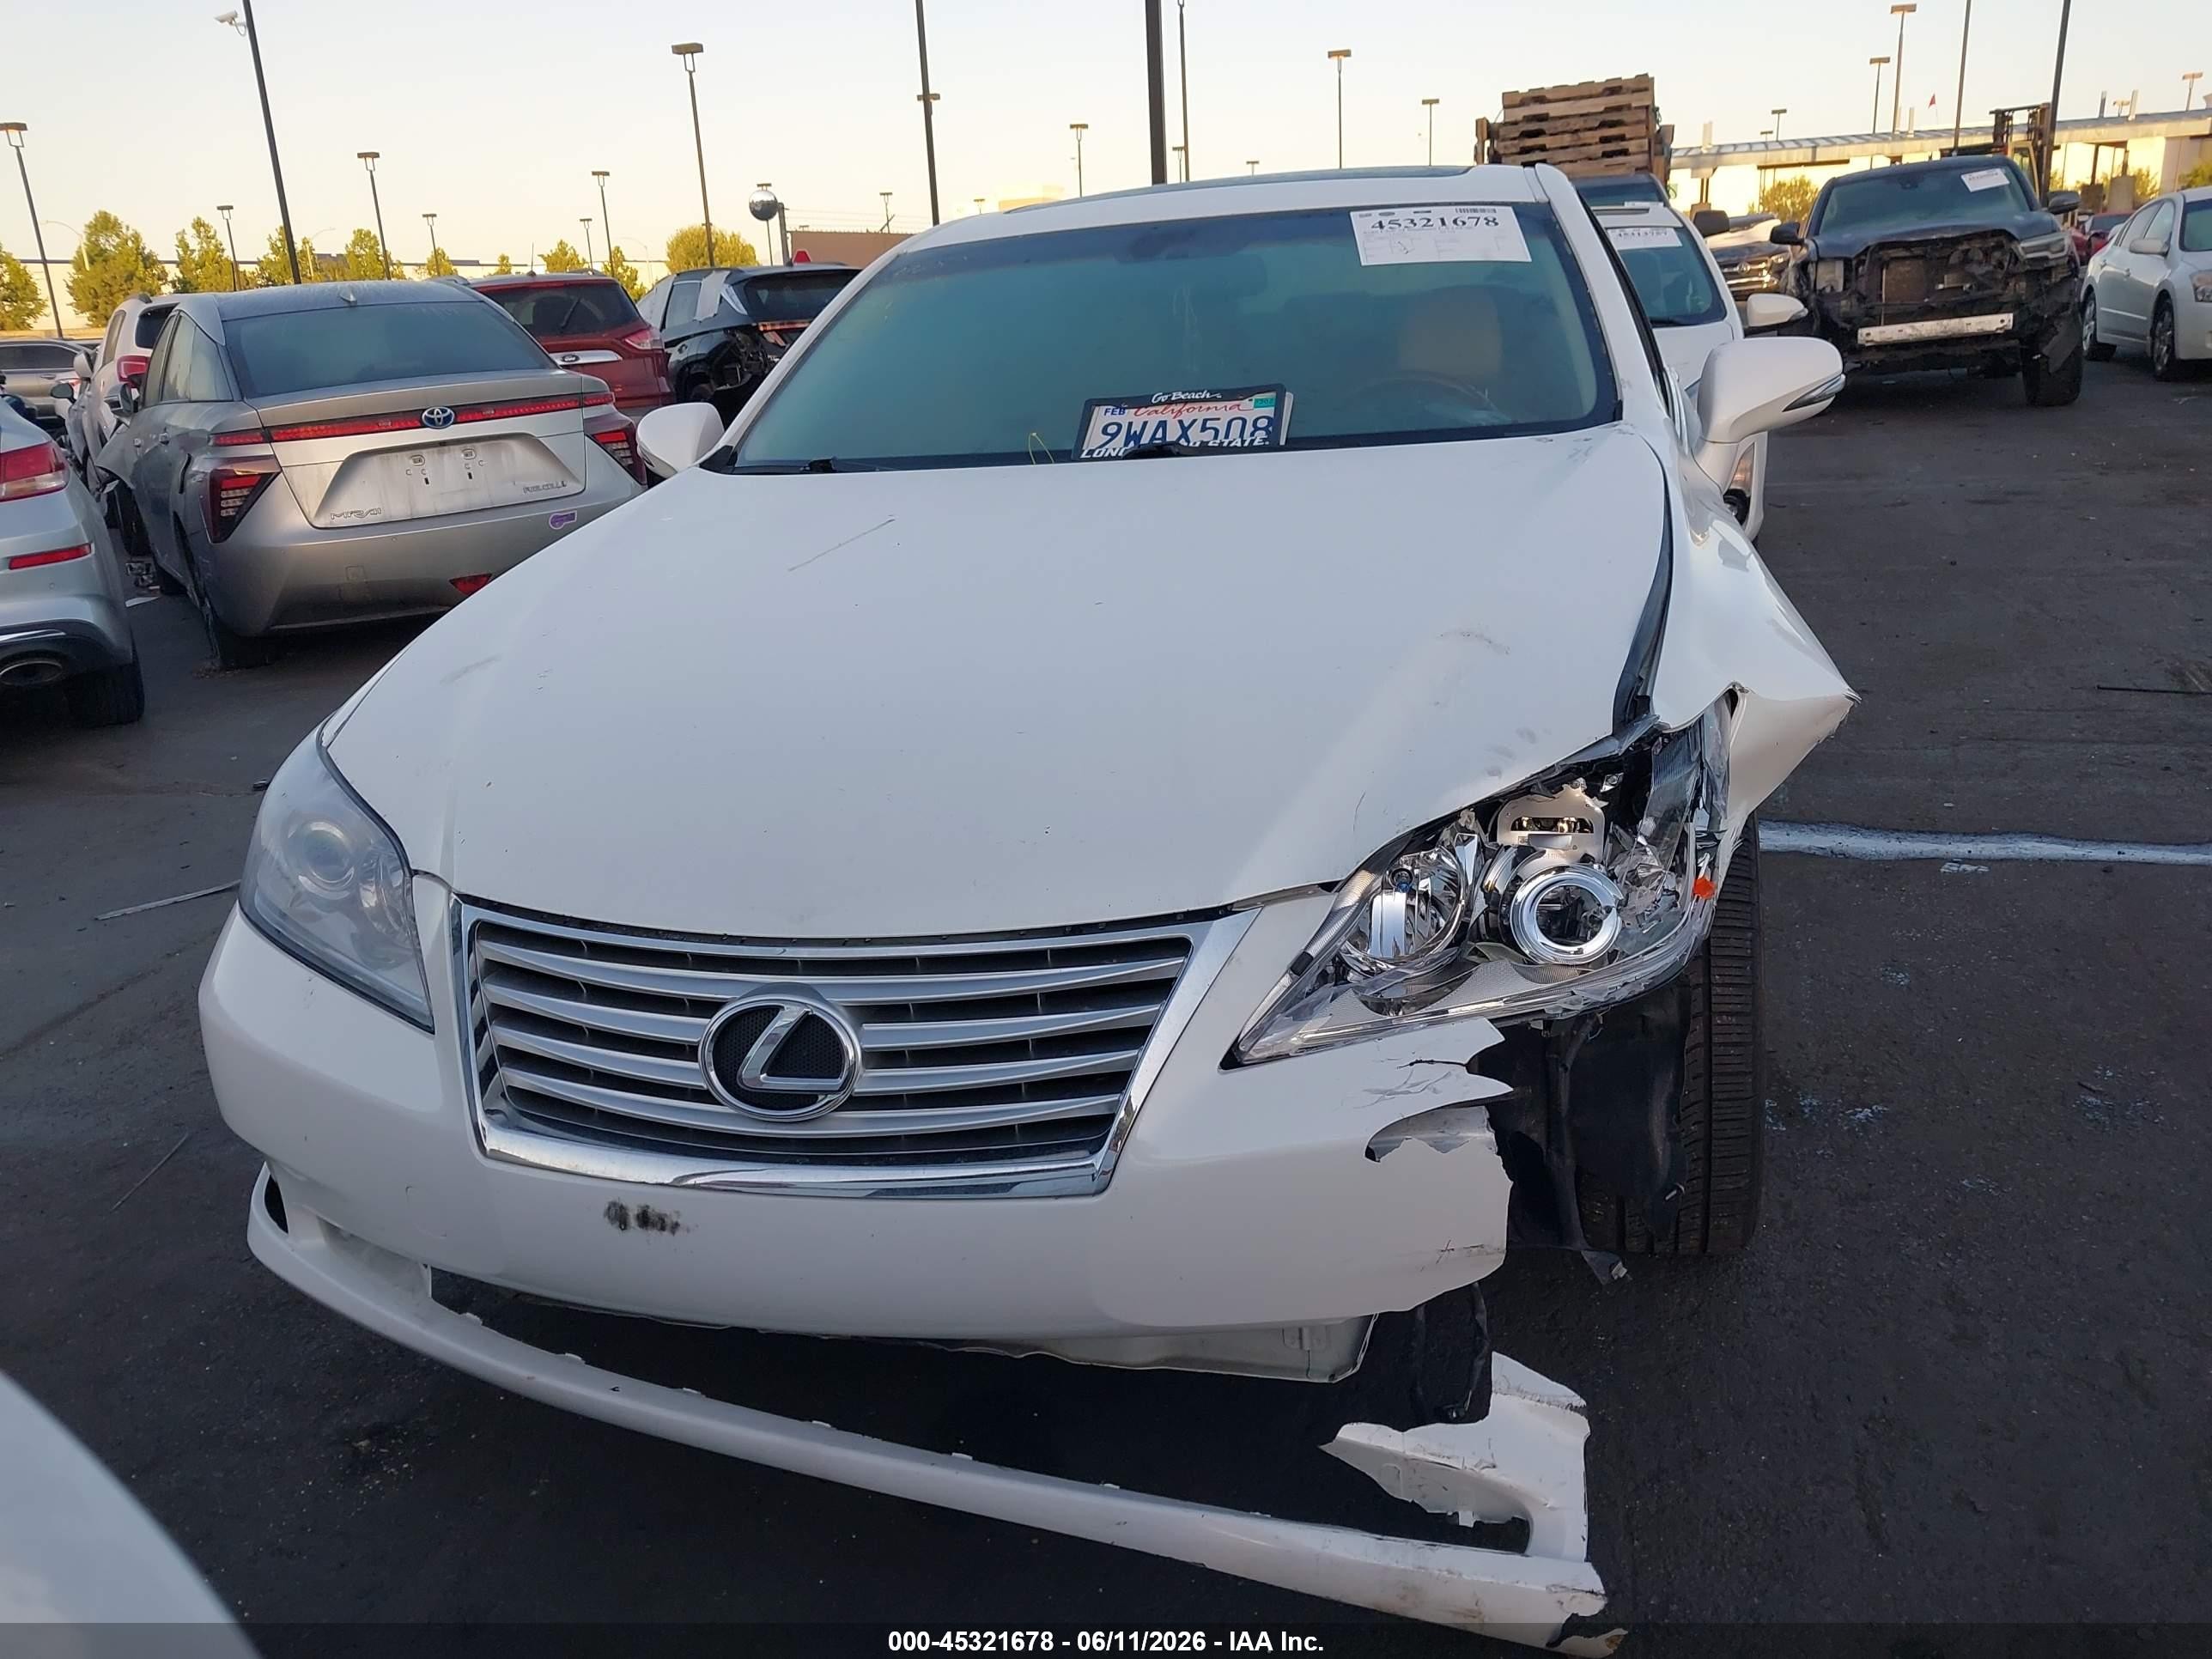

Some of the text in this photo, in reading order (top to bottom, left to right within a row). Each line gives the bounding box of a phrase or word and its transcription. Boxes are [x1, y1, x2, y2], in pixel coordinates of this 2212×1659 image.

[1370, 216, 1500, 231] 45321678
[1151, 389, 1217, 404] Go Beach
[1103, 407, 1127, 416] FEB
[1133, 402, 1254, 420] California
[1097, 415, 1273, 449] 9WAX508
